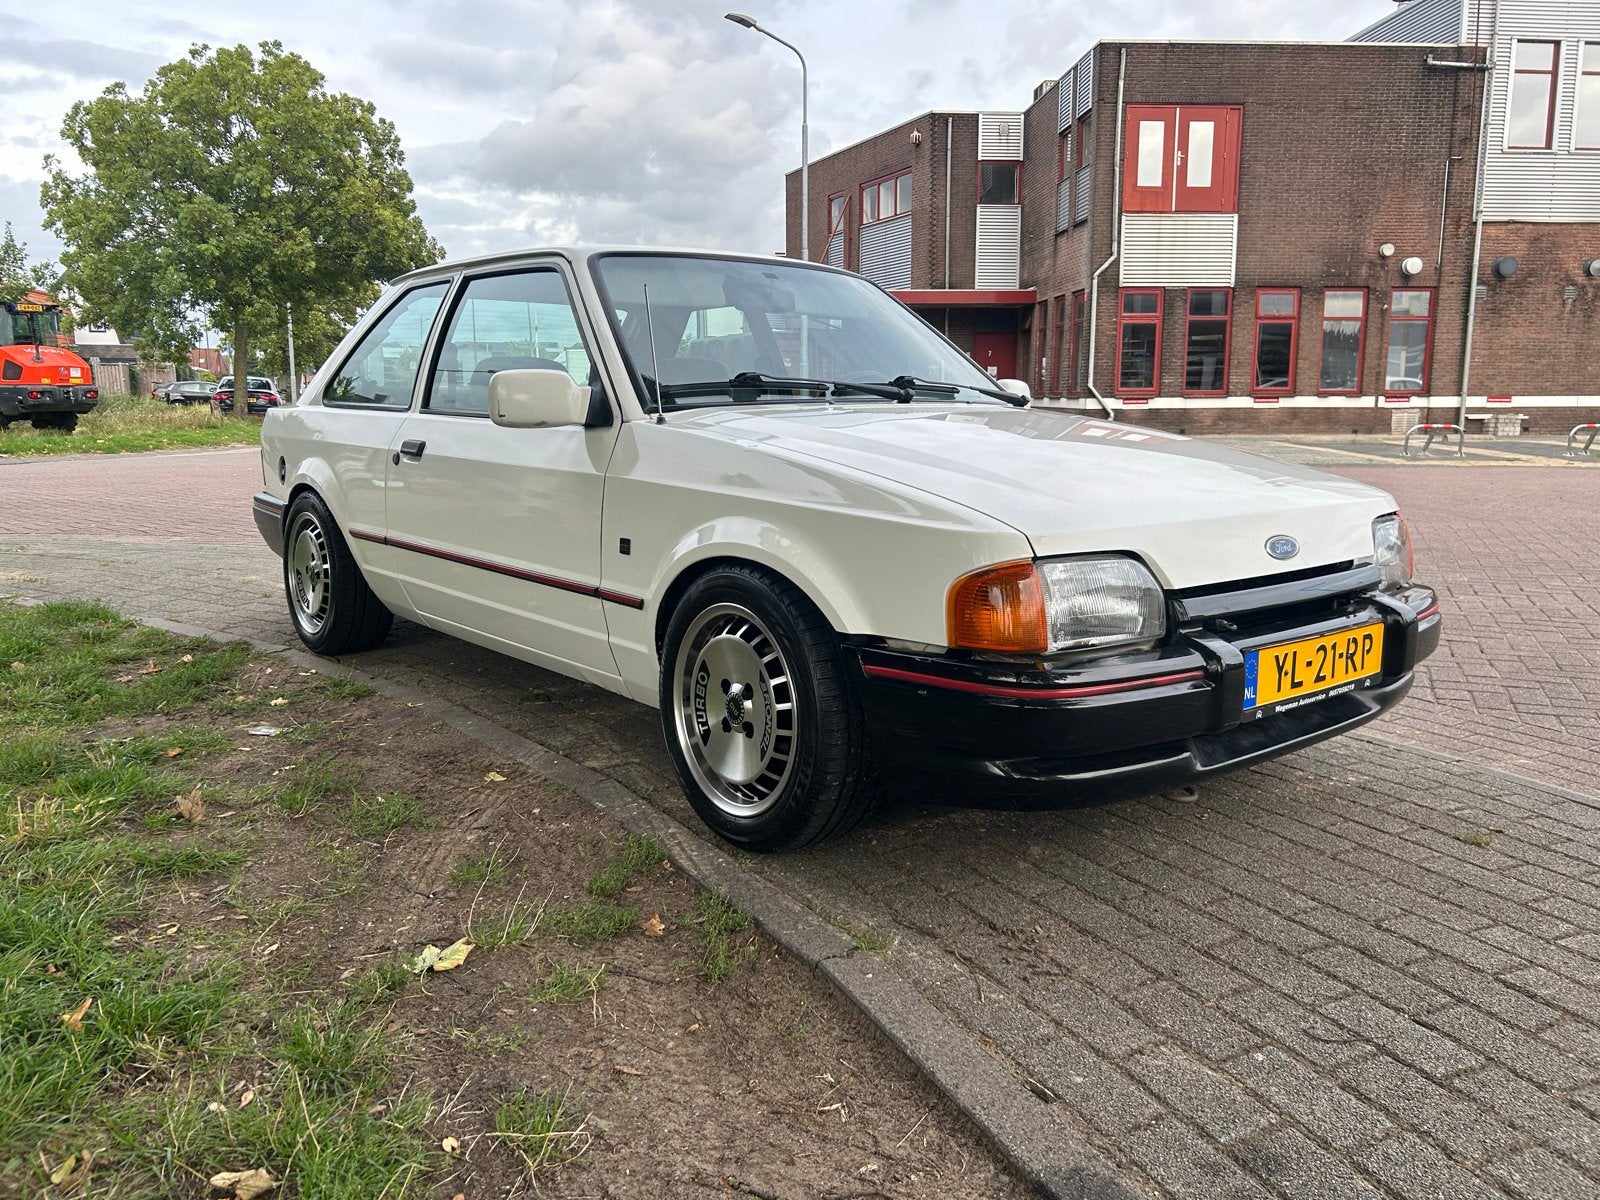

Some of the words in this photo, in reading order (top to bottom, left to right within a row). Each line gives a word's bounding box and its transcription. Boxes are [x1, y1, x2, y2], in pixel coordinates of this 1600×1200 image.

[1275, 540, 1293, 553] Ford
[1274, 633, 1373, 693] YL-21-RP
[696, 671, 708, 735] TURBO
[1244, 687, 1256, 700] NL
[760, 694, 773, 752] RONAL
